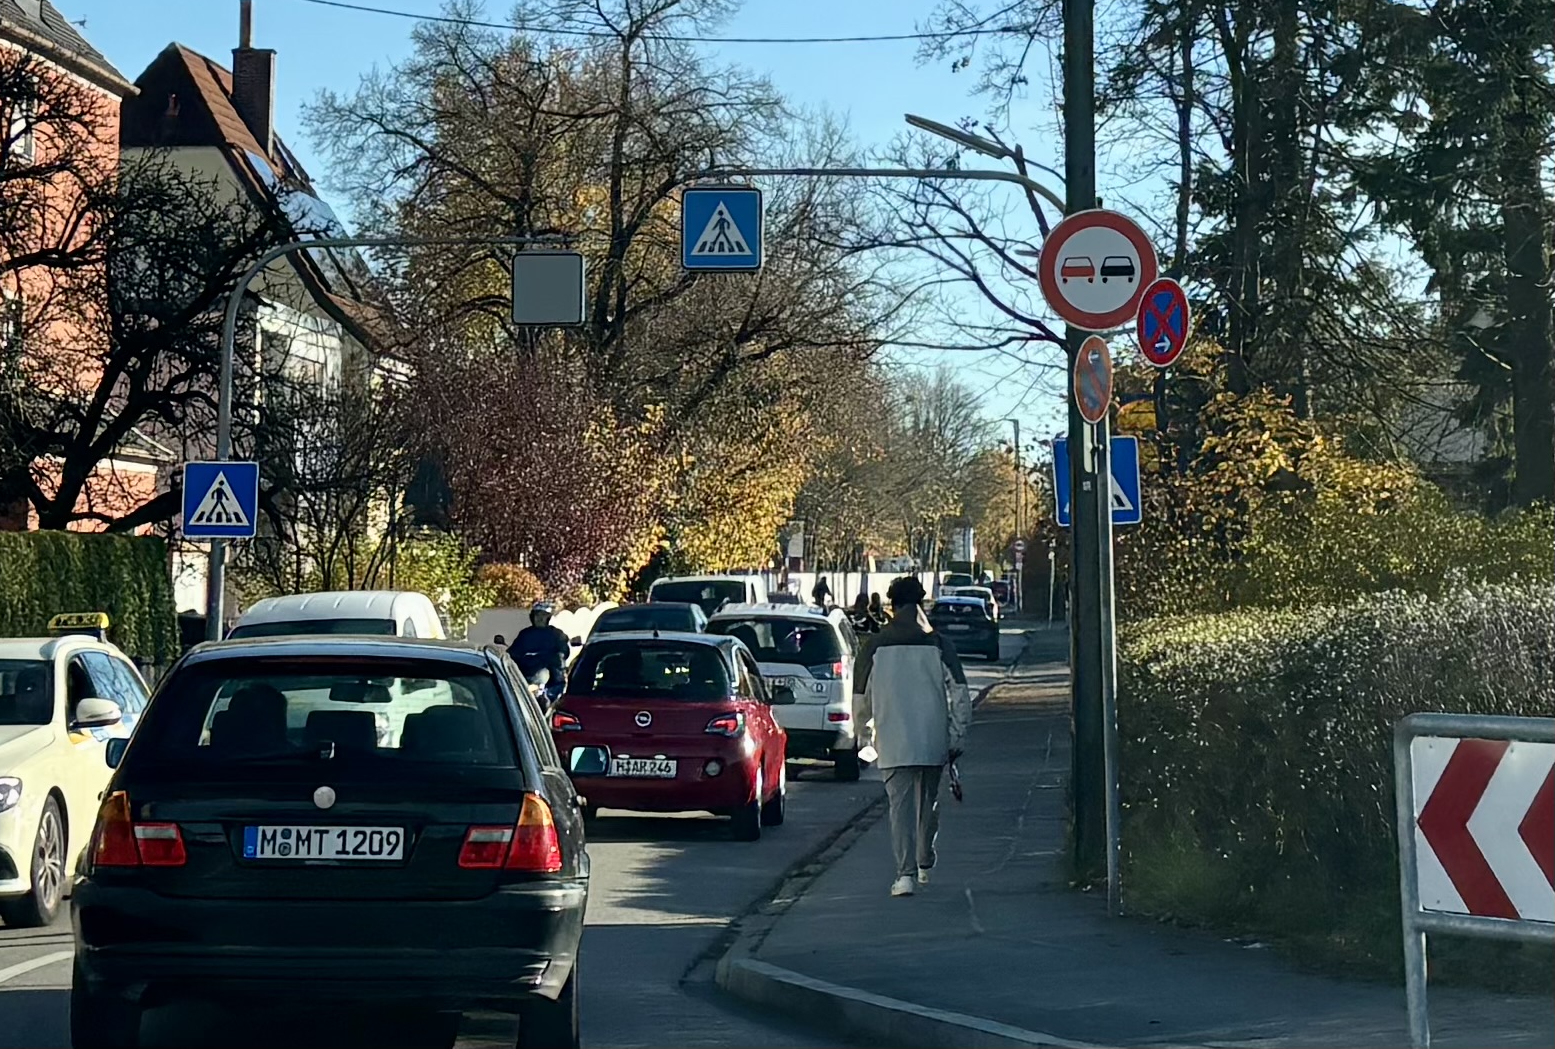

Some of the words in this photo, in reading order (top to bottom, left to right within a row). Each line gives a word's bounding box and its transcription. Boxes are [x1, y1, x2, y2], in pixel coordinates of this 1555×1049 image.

[260, 829, 277, 855] M
[295, 829, 330, 855] MT
[335, 830, 401, 856] 1209
